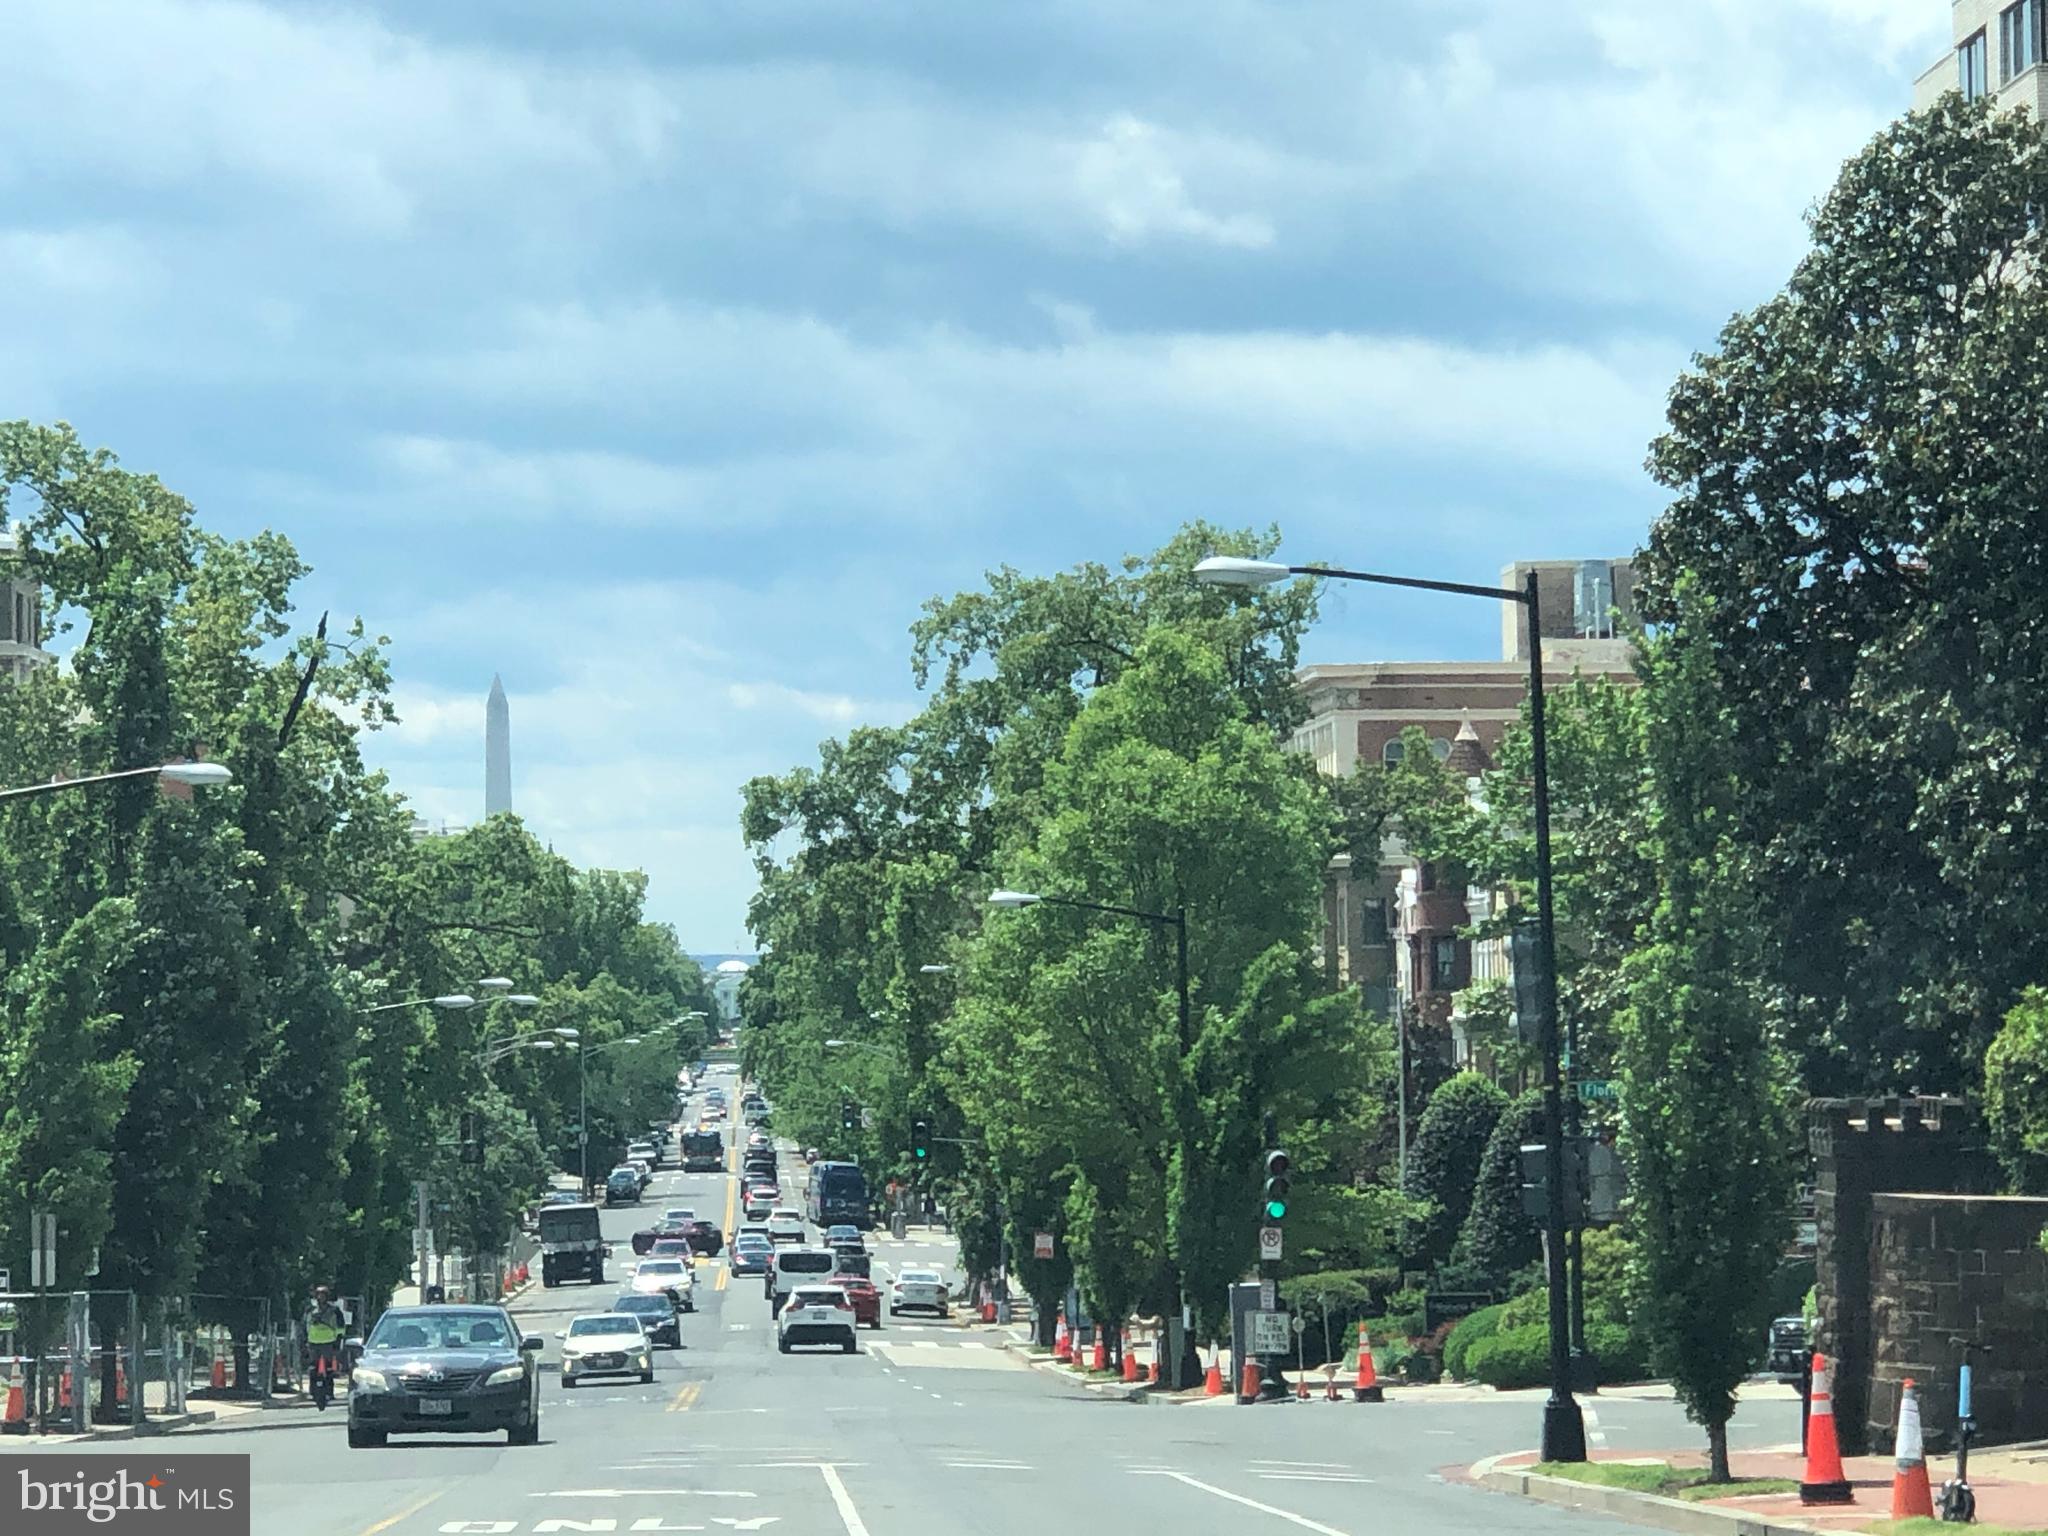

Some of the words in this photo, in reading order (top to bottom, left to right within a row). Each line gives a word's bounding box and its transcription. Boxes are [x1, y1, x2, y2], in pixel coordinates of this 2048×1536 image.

[1585, 1083, 1614, 1097] Flori
[1265, 1314, 1279, 1323] NO
[438, 1517, 782, 1534] ONLY
